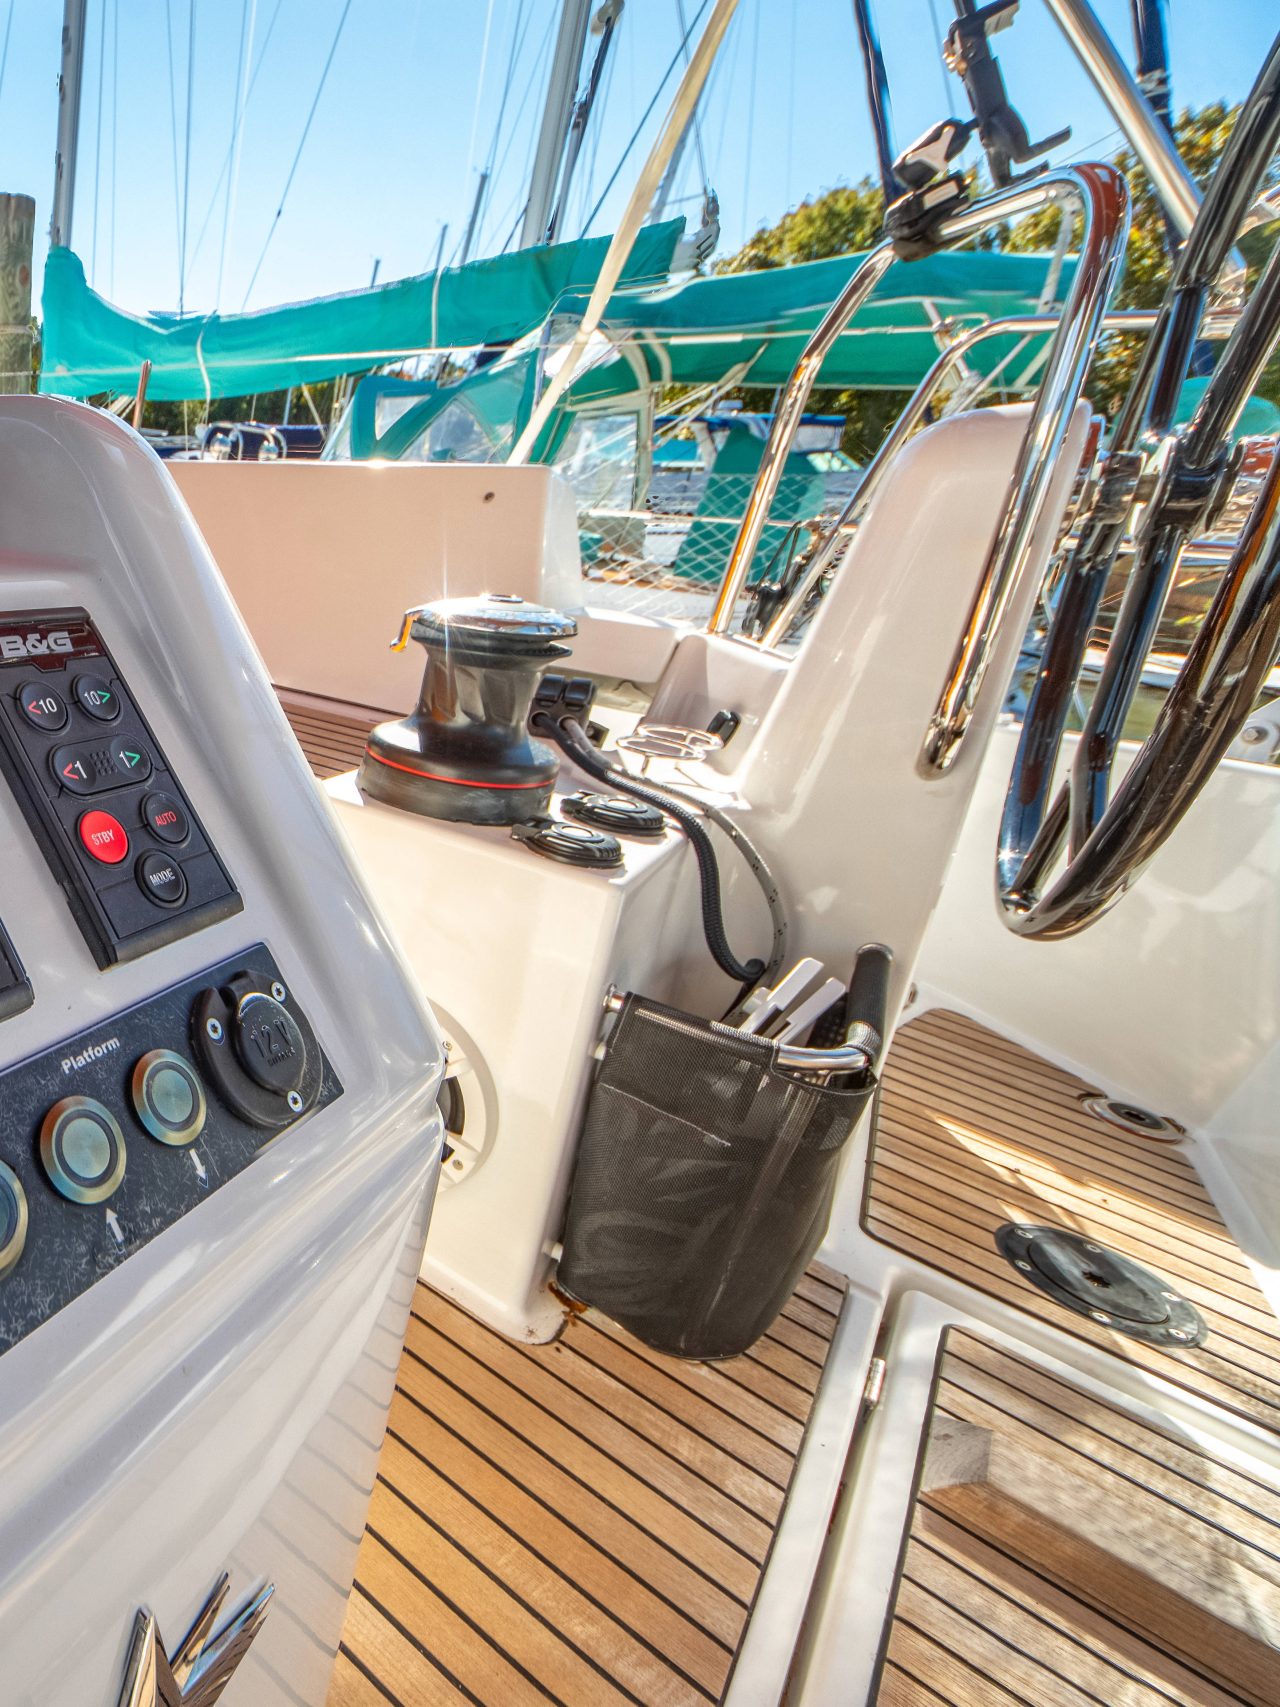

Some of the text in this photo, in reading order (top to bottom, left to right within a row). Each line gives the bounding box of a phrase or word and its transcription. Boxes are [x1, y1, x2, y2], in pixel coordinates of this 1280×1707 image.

[154, 811, 177, 827] AUTO
[91, 829, 116, 846] STBY
[149, 867, 176, 886] MODE
[61, 1037, 121, 1074] Platform
